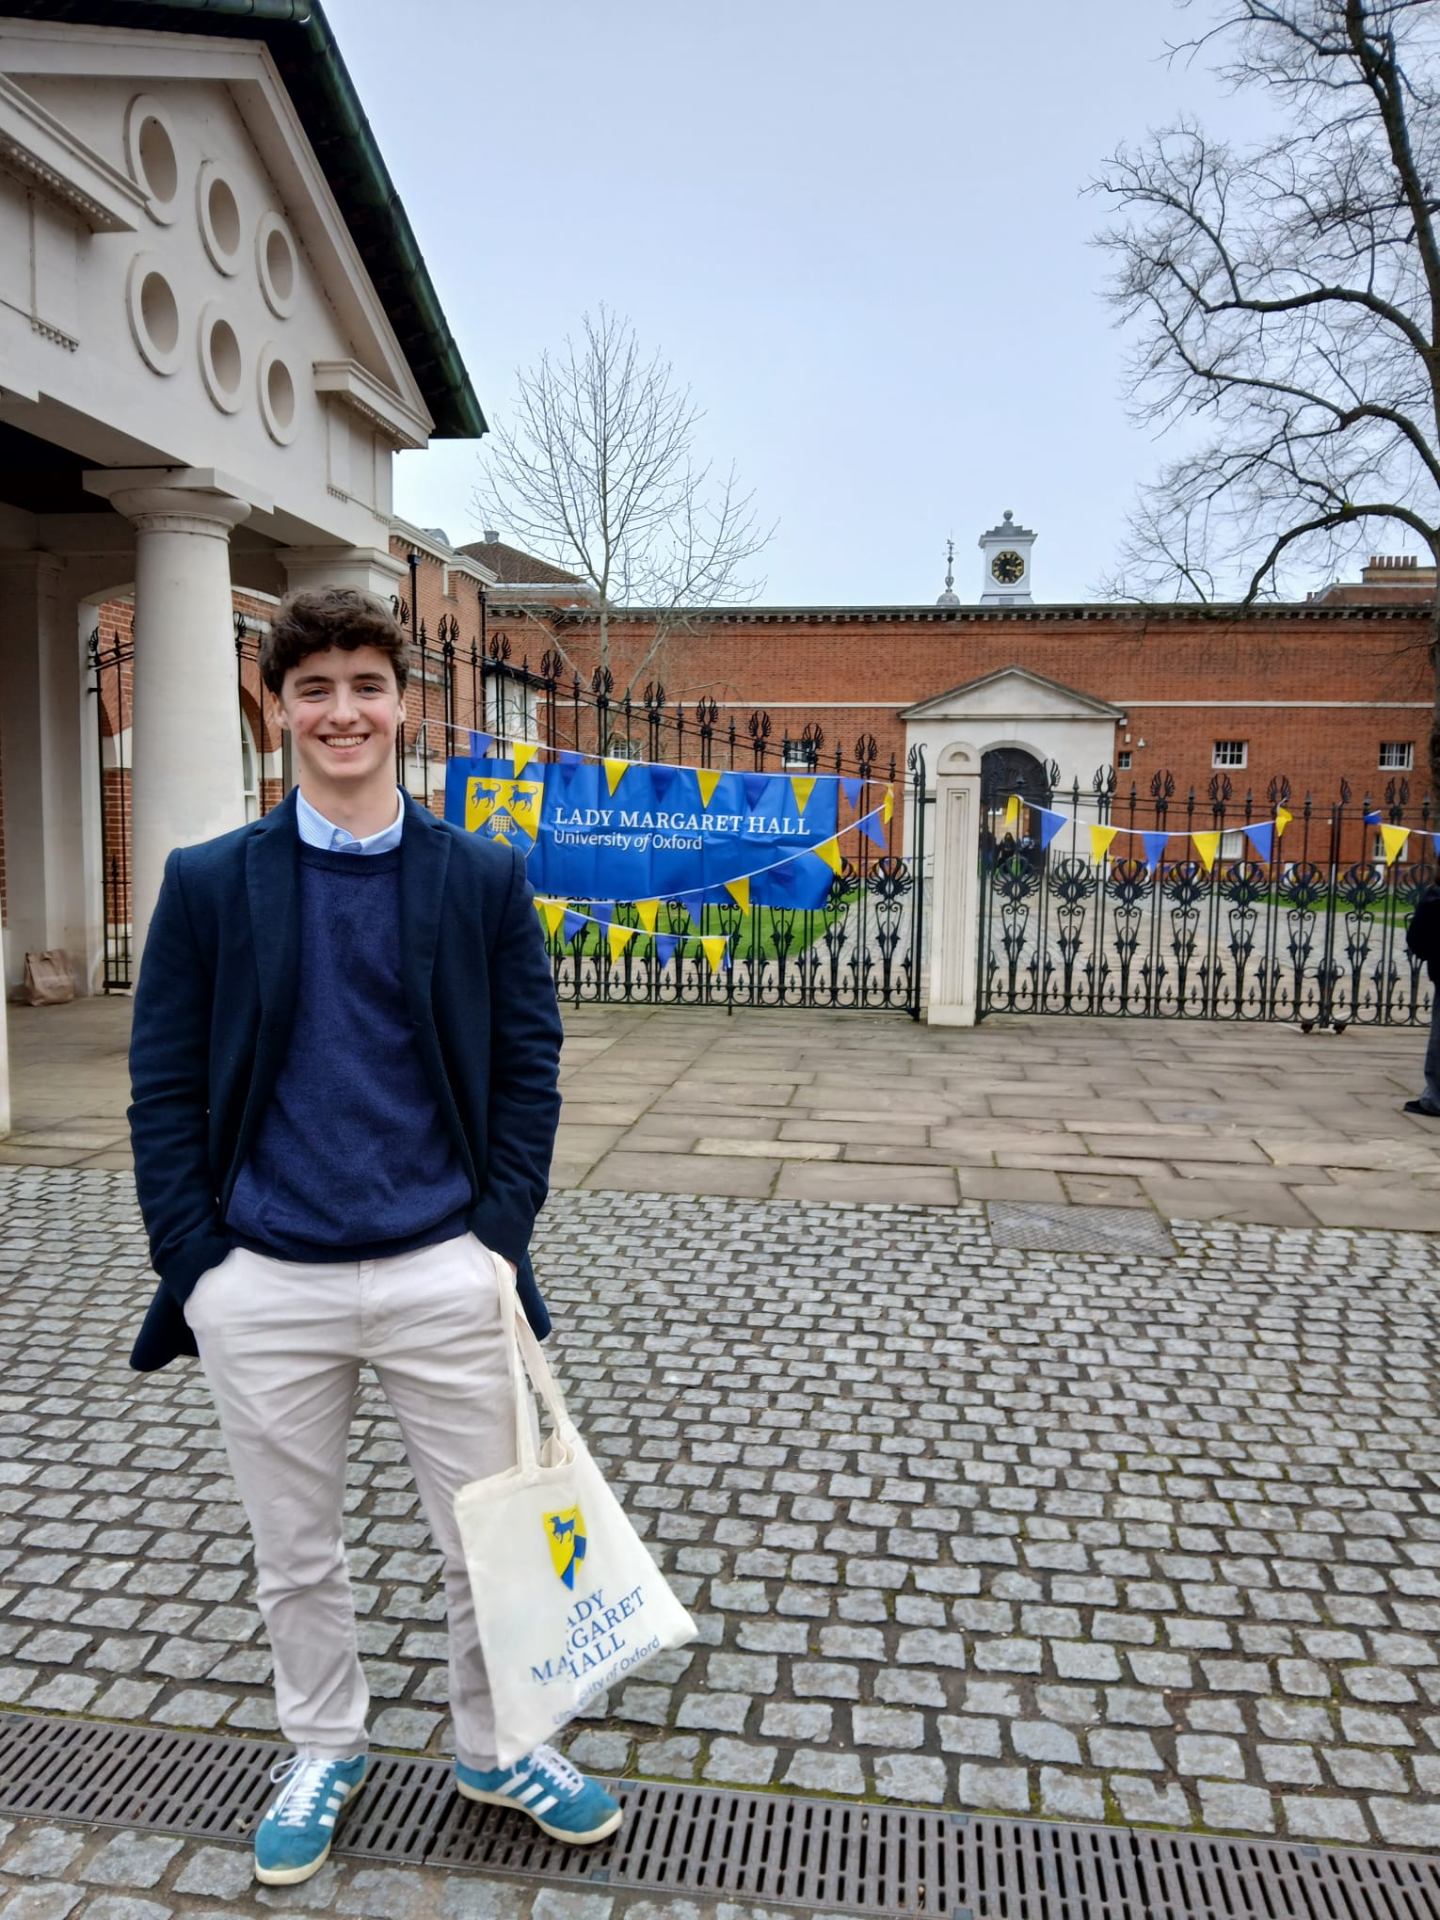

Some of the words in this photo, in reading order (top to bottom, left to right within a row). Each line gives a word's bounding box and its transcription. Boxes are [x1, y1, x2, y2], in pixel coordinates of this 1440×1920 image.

[555, 807, 614, 827] LADY
[619, 810, 743, 832] MARGARET
[747, 816, 811, 835] HALL
[553, 830, 632, 851] University
[633, 832, 652, 853] of
[652, 834, 703, 850] Oxford
[567, 1589, 606, 1628] DY
[619, 1634, 660, 1671] Oxford
